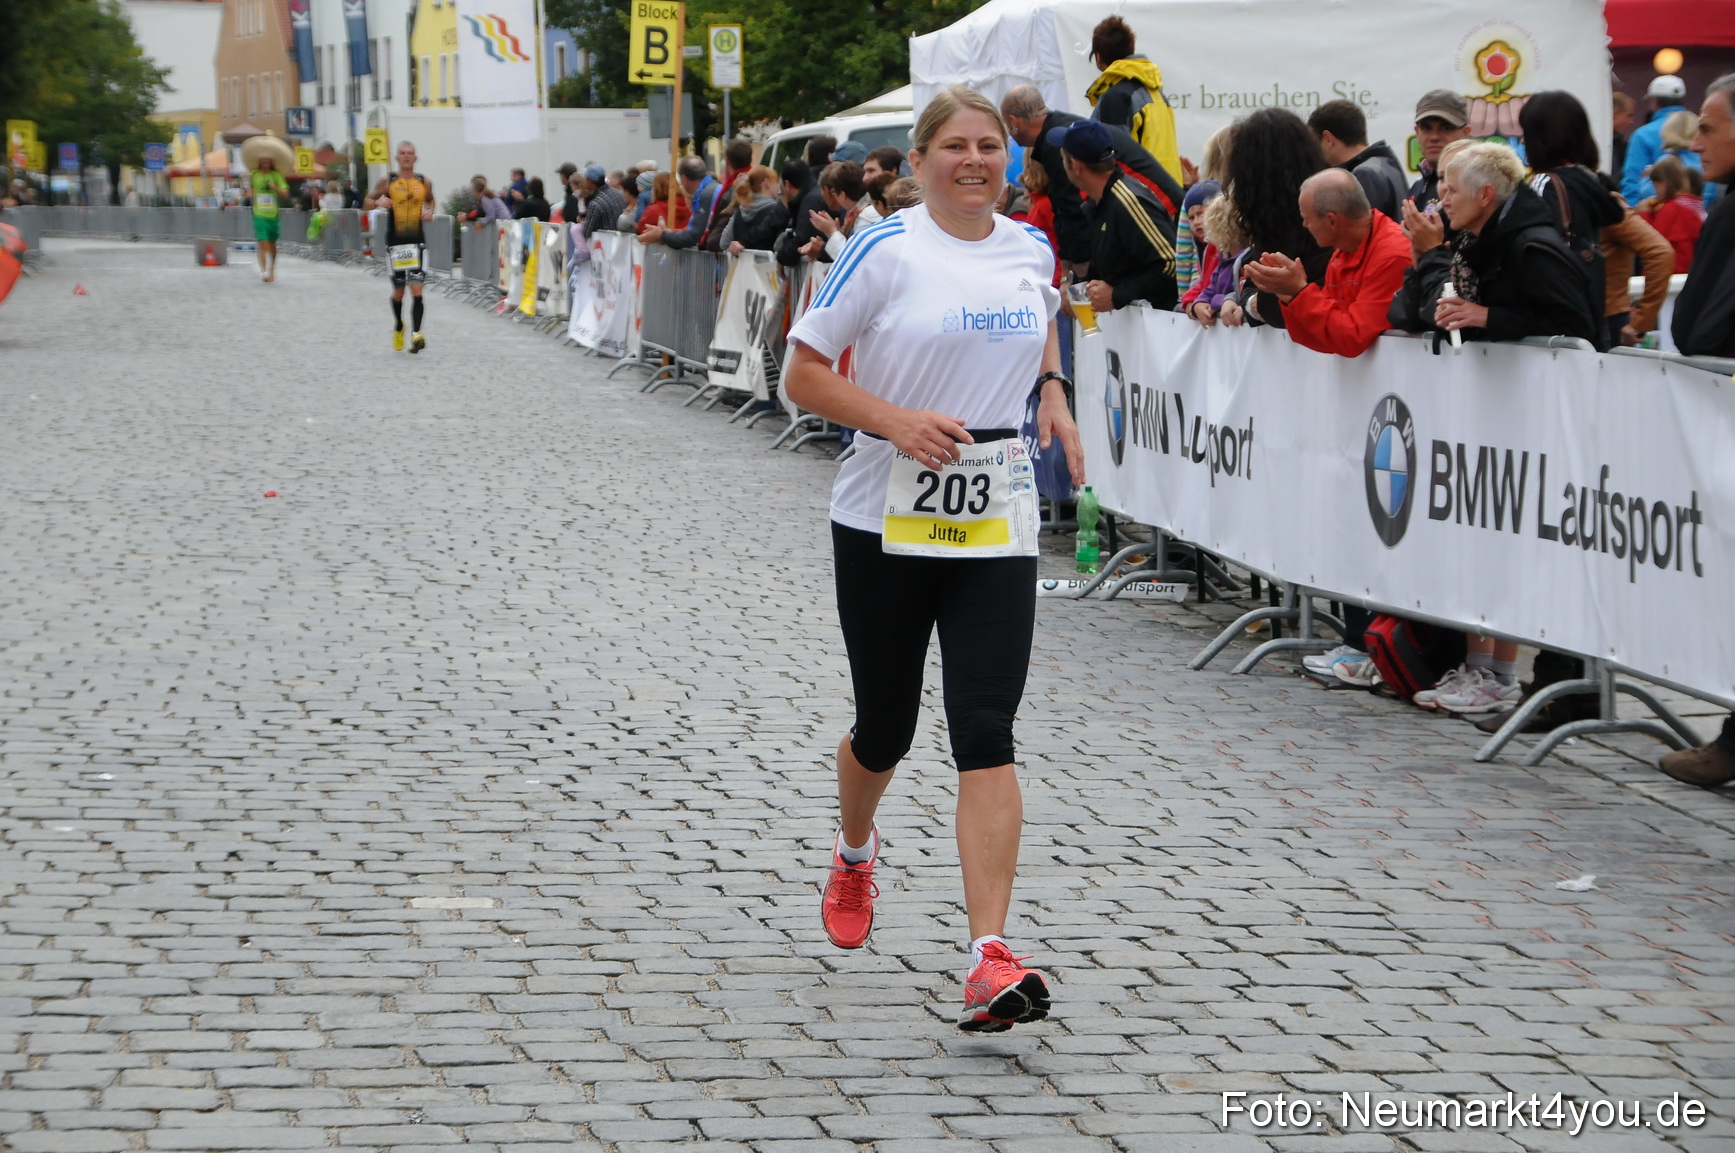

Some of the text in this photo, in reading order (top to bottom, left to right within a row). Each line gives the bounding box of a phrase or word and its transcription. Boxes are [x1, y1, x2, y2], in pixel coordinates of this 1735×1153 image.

[638, 3, 678, 19] Block
[645, 27, 668, 64] B
[1200, 83, 1320, 109] brauchen
[1332, 80, 1379, 107] Sie.
[370, 138, 382, 156] C
[301, 154, 308, 167] D
[962, 305, 1038, 330] heinloth
[947, 455, 994, 467] eumarkt
[913, 470, 990, 515] 203
[889, 506, 895, 514] D
[1428, 438, 1704, 584] BMW Laufsport
[928, 523, 966, 543] Jutta
